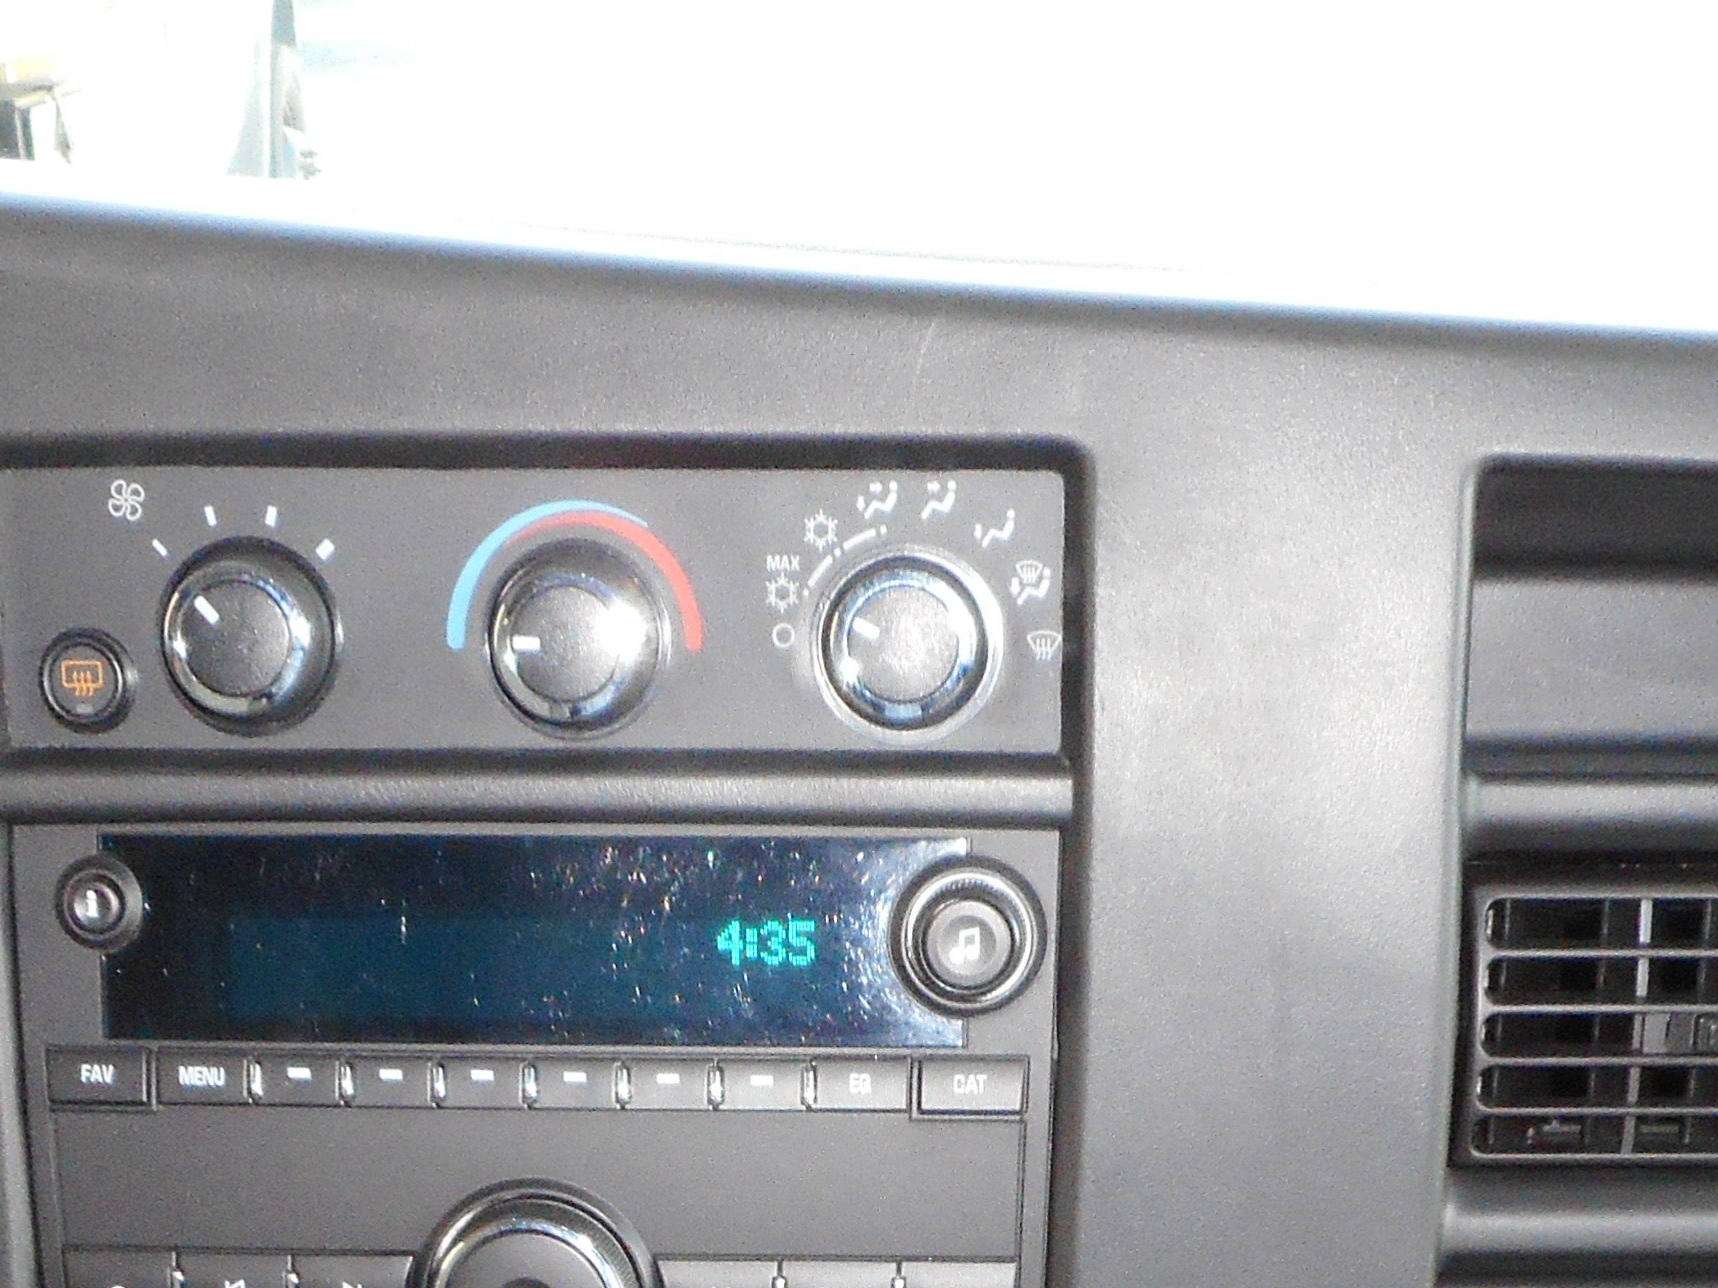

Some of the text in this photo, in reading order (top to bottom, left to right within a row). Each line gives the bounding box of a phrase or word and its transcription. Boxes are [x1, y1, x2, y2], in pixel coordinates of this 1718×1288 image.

[766, 554, 800, 572] MAX
[717, 919, 816, 967] 4:35
[80, 1063, 115, 1084] FAV
[179, 1065, 226, 1088] MENU
